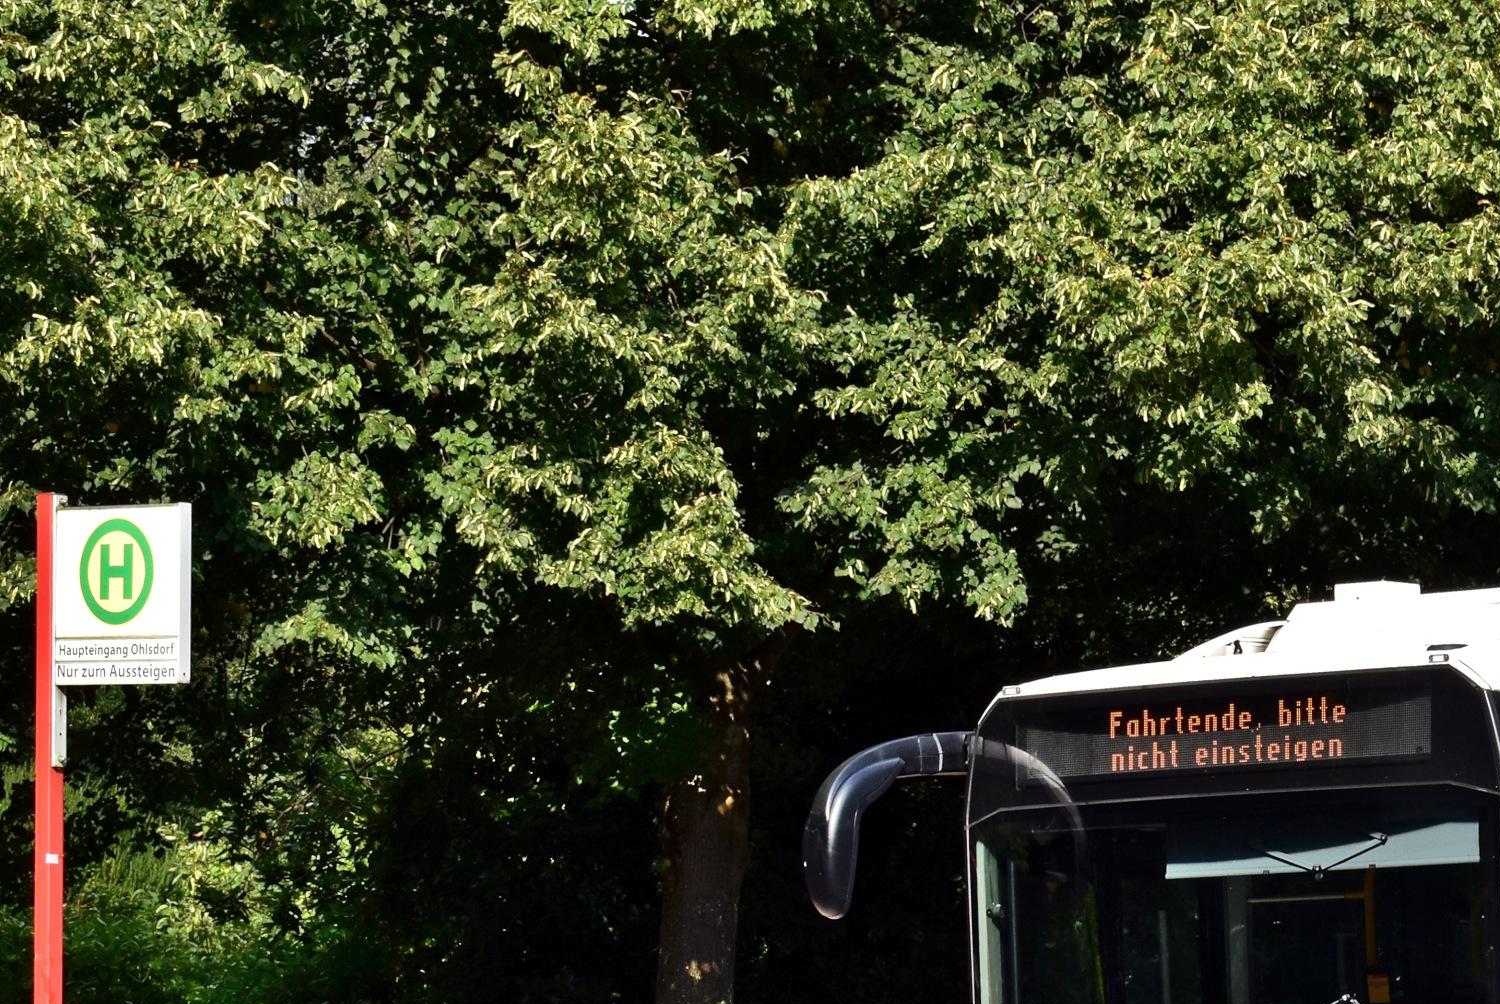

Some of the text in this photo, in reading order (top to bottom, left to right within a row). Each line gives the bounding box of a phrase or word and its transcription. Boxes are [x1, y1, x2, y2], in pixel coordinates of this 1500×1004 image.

[99, 543, 133, 600] H
[58, 643, 174, 659] Haupteingang Ohlsdorf
[57, 664, 175, 681] Nur zum Aussteigen
[1110, 696, 1346, 738] Fahrtende, bitte
[1111, 735, 1342, 772] nicht einsteigen
